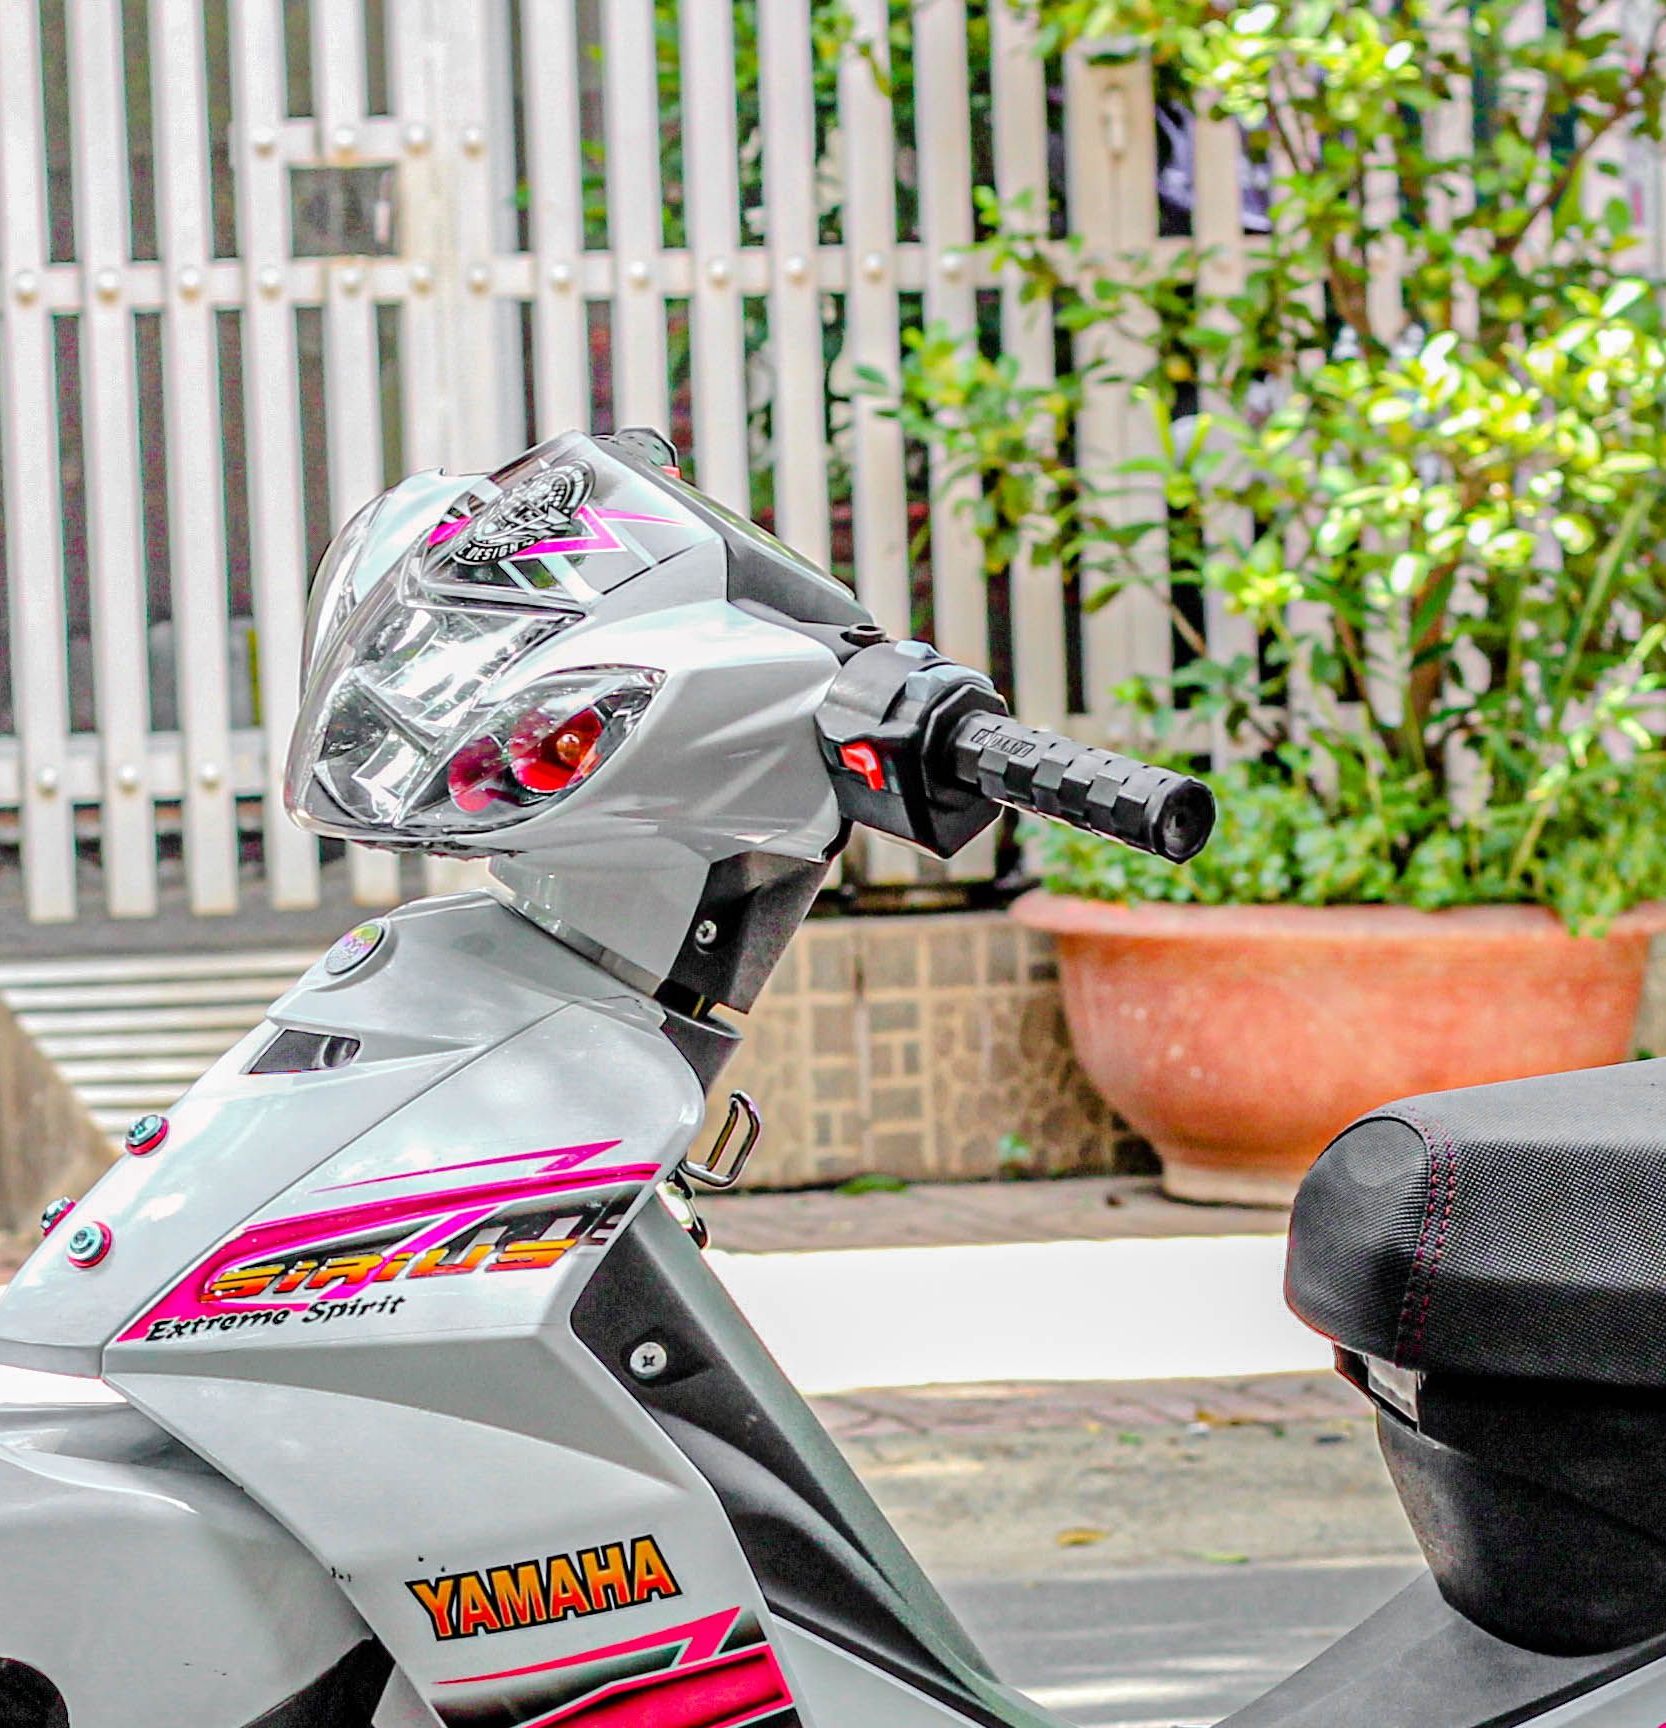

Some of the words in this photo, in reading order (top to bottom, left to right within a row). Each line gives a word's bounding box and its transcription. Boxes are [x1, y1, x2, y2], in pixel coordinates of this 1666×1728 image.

[145, 1309, 290, 1343] Extreme
[300, 1294, 406, 1325] Spirit
[405, 1534, 682, 1641] YAMAHA
